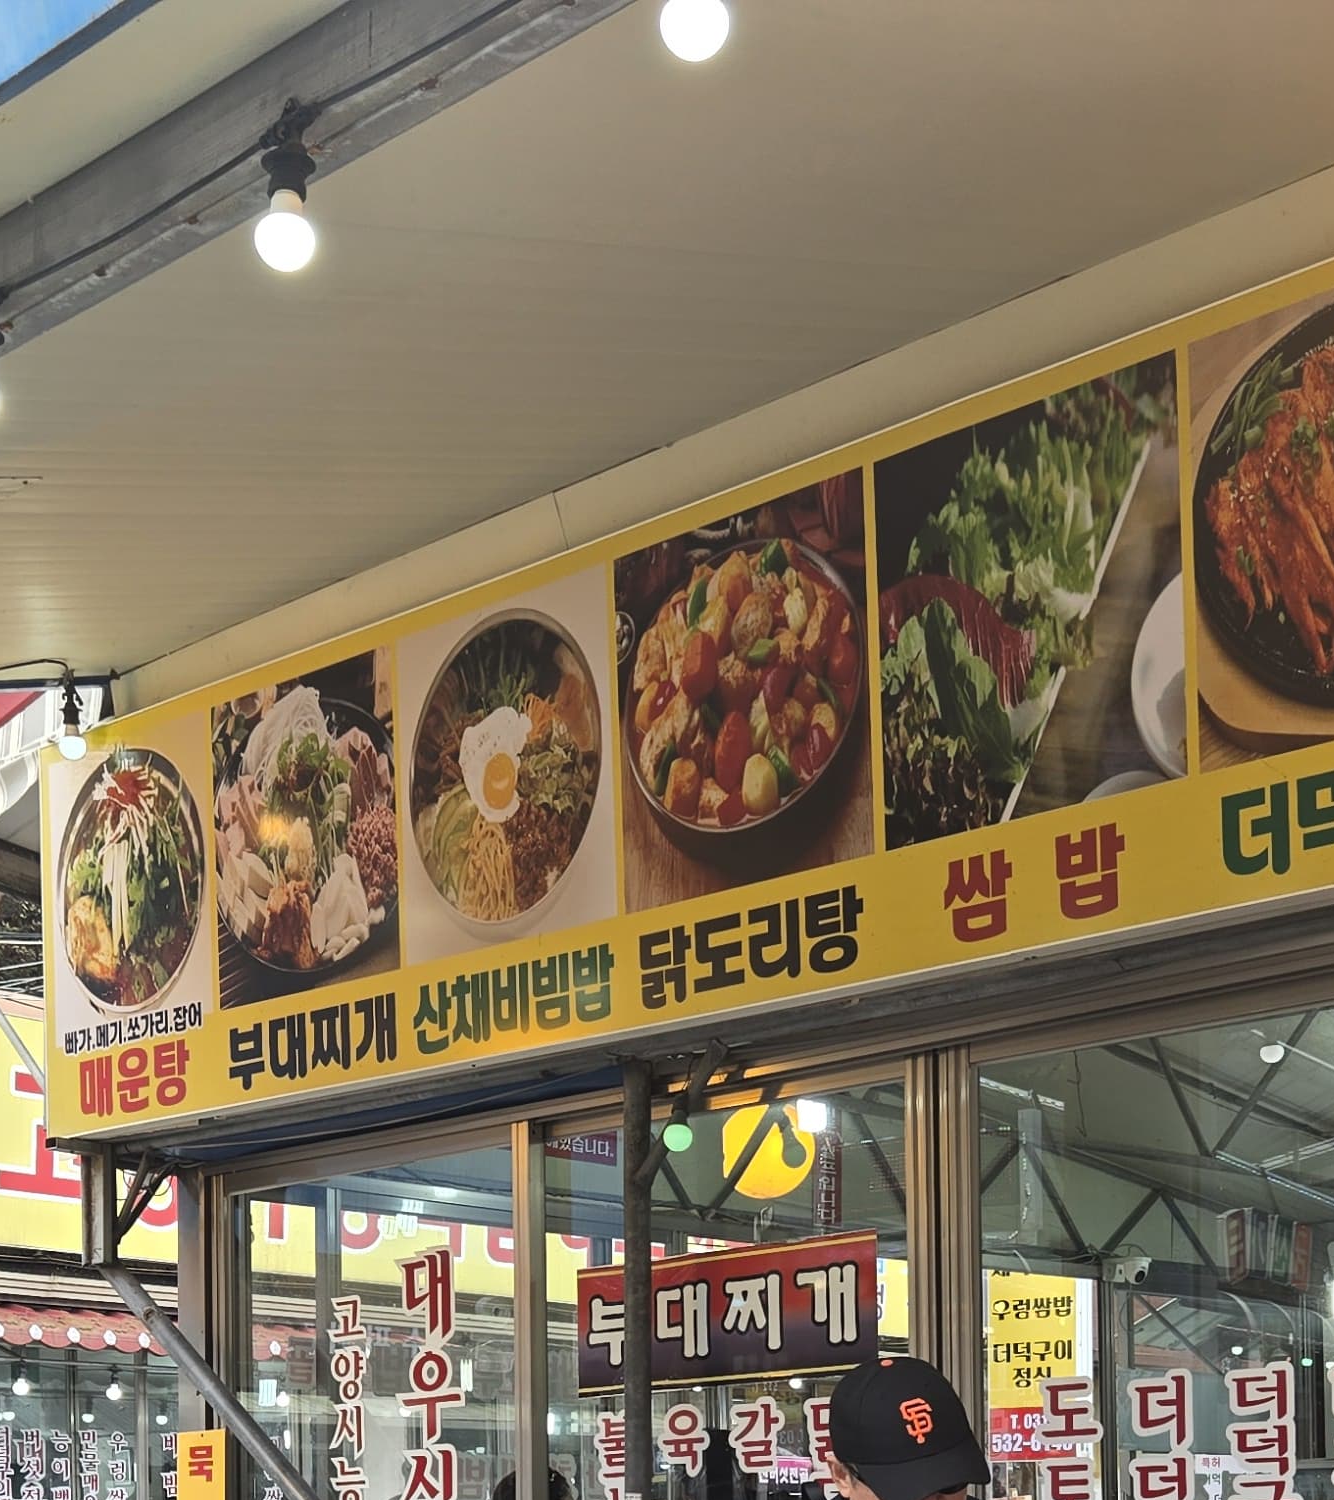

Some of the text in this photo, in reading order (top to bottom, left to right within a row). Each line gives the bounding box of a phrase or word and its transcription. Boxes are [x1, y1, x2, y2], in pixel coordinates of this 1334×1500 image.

[639, 885, 864, 1010] 닭도리탕
[228, 993, 398, 1090] 부대찌개
[413, 943, 615, 1055] 산채비빔밥
[80, 1039, 190, 1117] 매운탕
[588, 1260, 860, 1367] 부대찌개
[992, 1296, 1073, 1321] 우렁쌈밥
[993, 1339, 1072, 1363] 더덕구이
